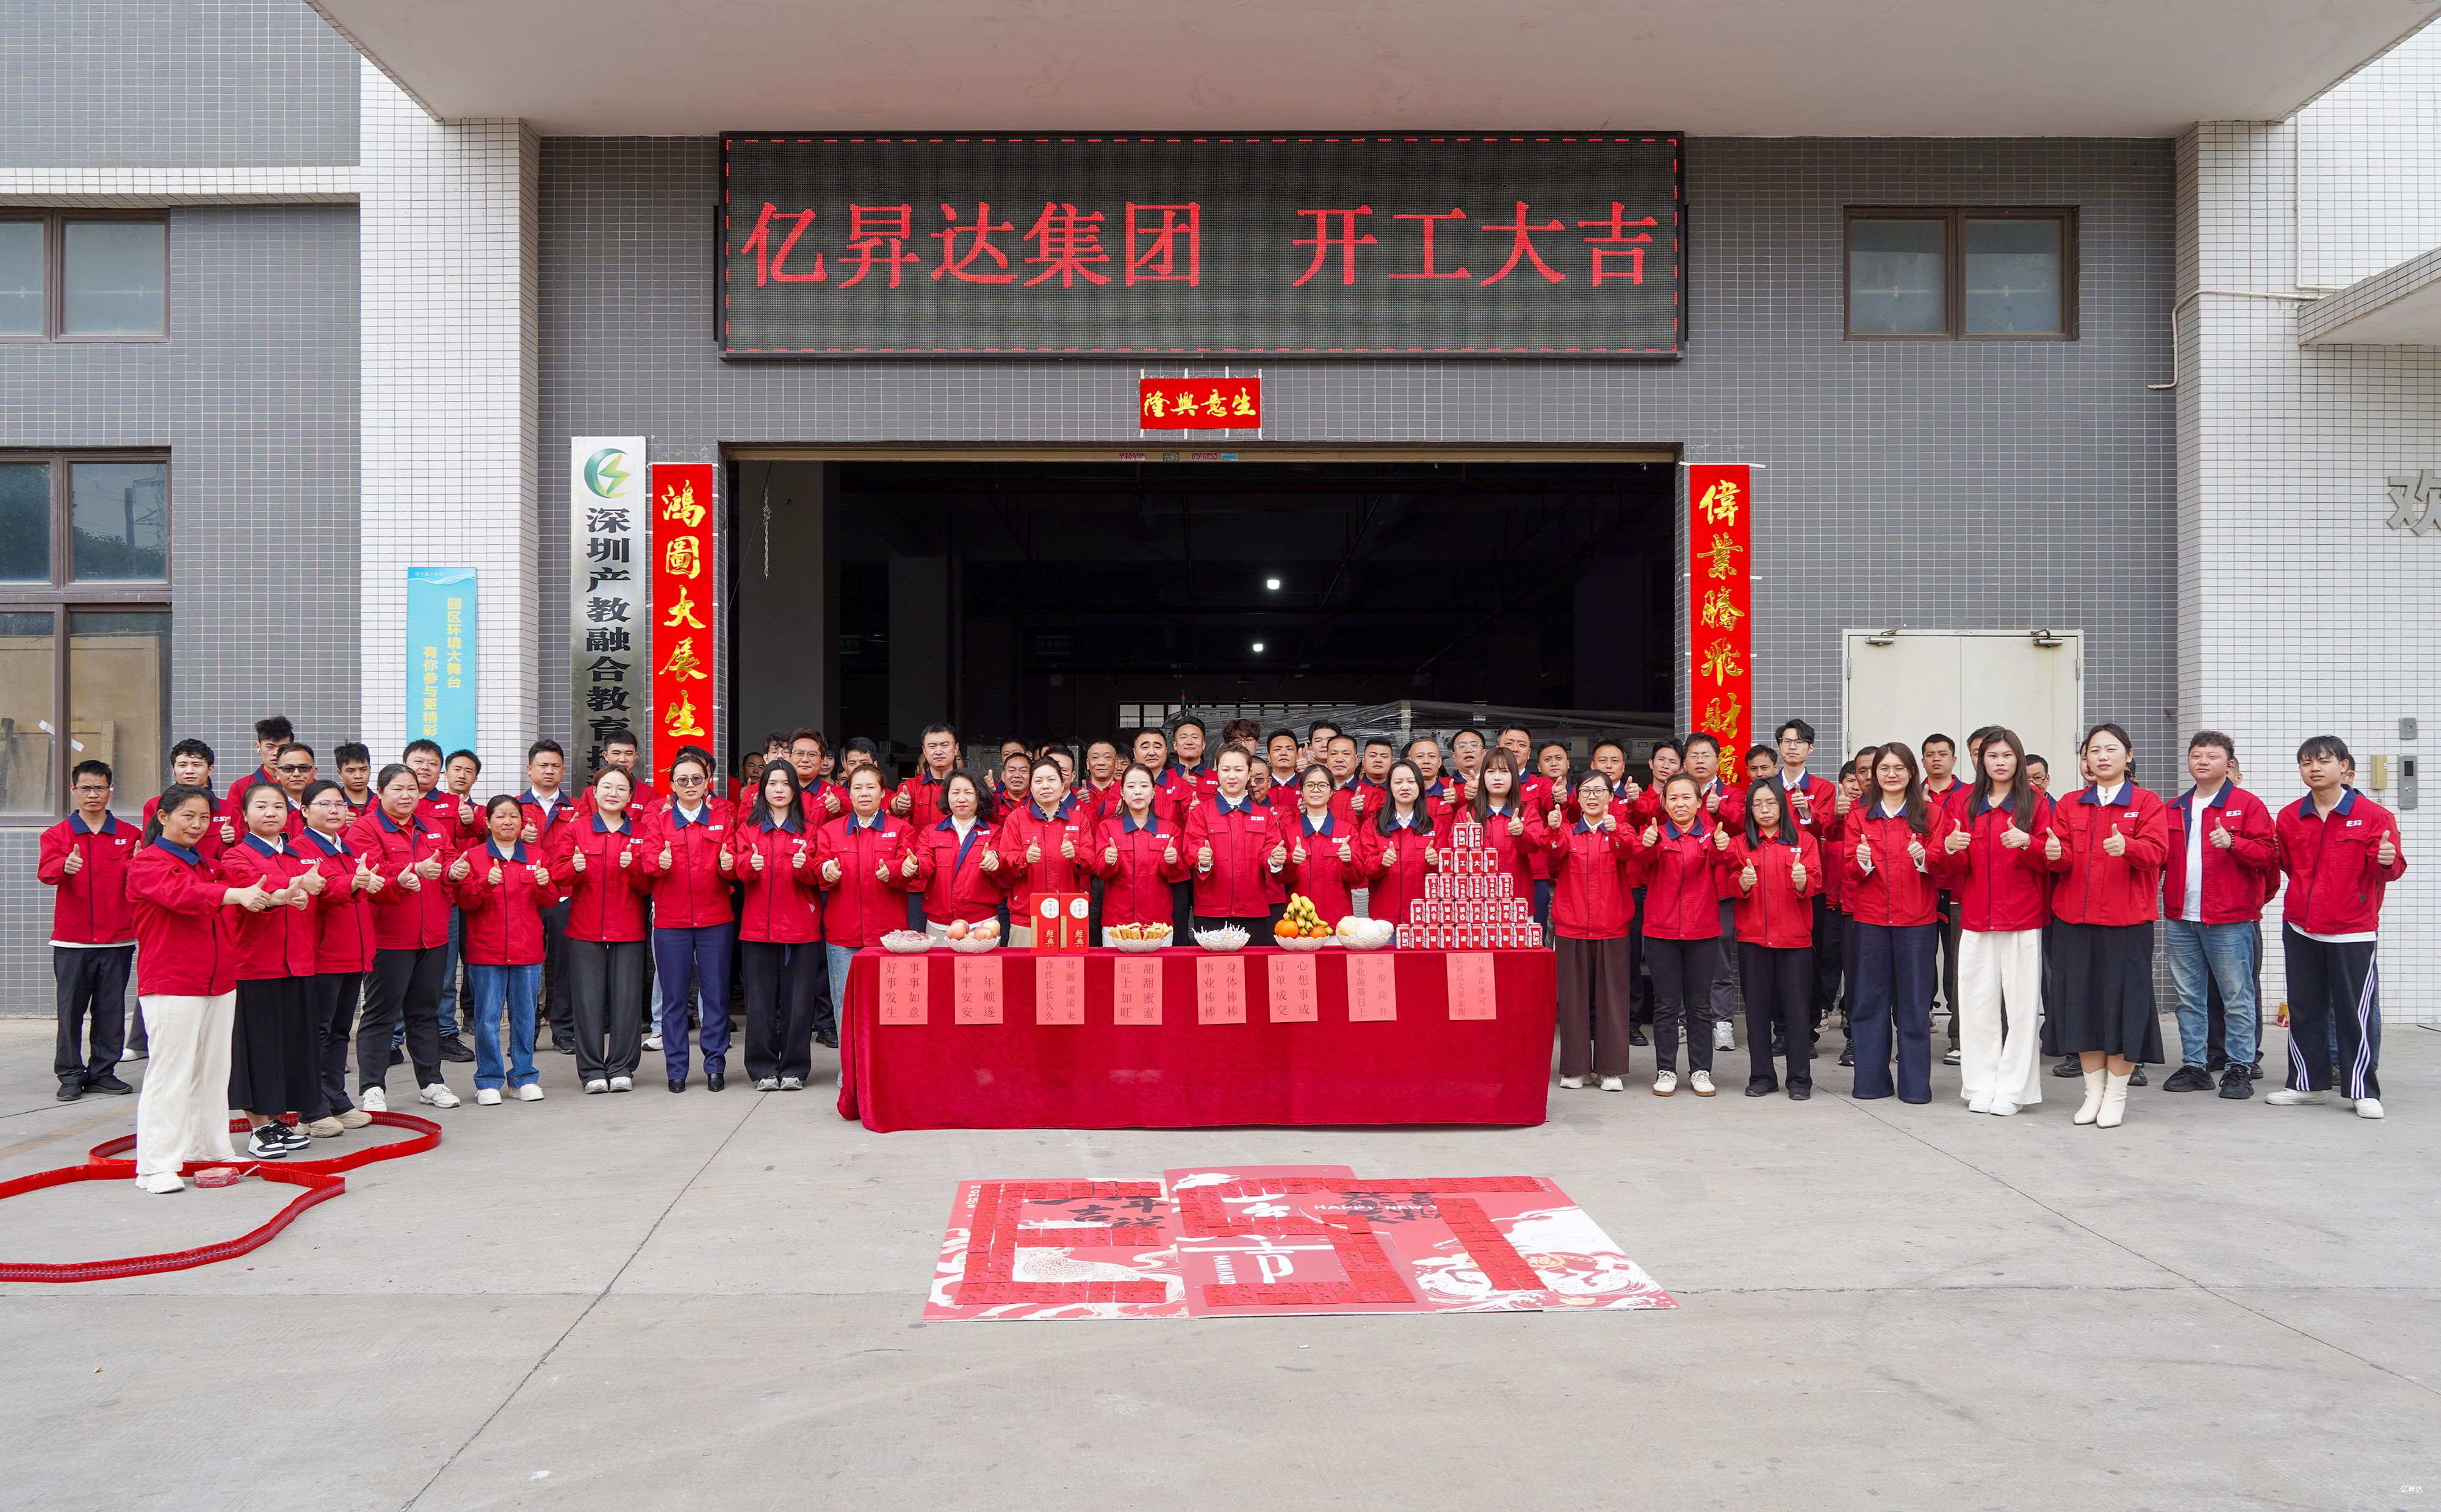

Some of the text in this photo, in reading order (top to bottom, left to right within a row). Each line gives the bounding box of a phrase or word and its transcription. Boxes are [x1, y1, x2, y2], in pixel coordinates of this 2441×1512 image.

[741, 201, 1658, 289] 亿昇达集团 开工大吉
[447, 598, 462, 688] 园区环境大舞台
[586, 508, 631, 786] 深圳产教融合教育
[423, 646, 438, 736] 有你参与更精彩
[885, 962, 898, 1018] 好事发生
[908, 962, 920, 1018] 事事如意
[961, 962, 973, 1018] 平平安安
[983, 965, 995, 1018] 一年顺遂
[1044, 960, 1055, 1021] 合作长长久久
[1065, 959, 1076, 1021] 财源滚滚来
[1120, 962, 1132, 1018] 旺上加旺
[1143, 963, 1155, 1018] 甜甜蜜蜜
[1202, 962, 1216, 1019] 事业棒棒
[1225, 961, 1239, 1017] 身体棒棒
[1274, 960, 1288, 1017] 订单成交
[1297, 960, 1311, 1016] 心想事成
[1356, 957, 1367, 1017] 事业蒸蒸日上
[1377, 957, 1388, 1017] 步步高升
[1455, 956, 1466, 1016] 亿昇达大展宏图
[1477, 956, 1487, 1016] 万事百事可乐
